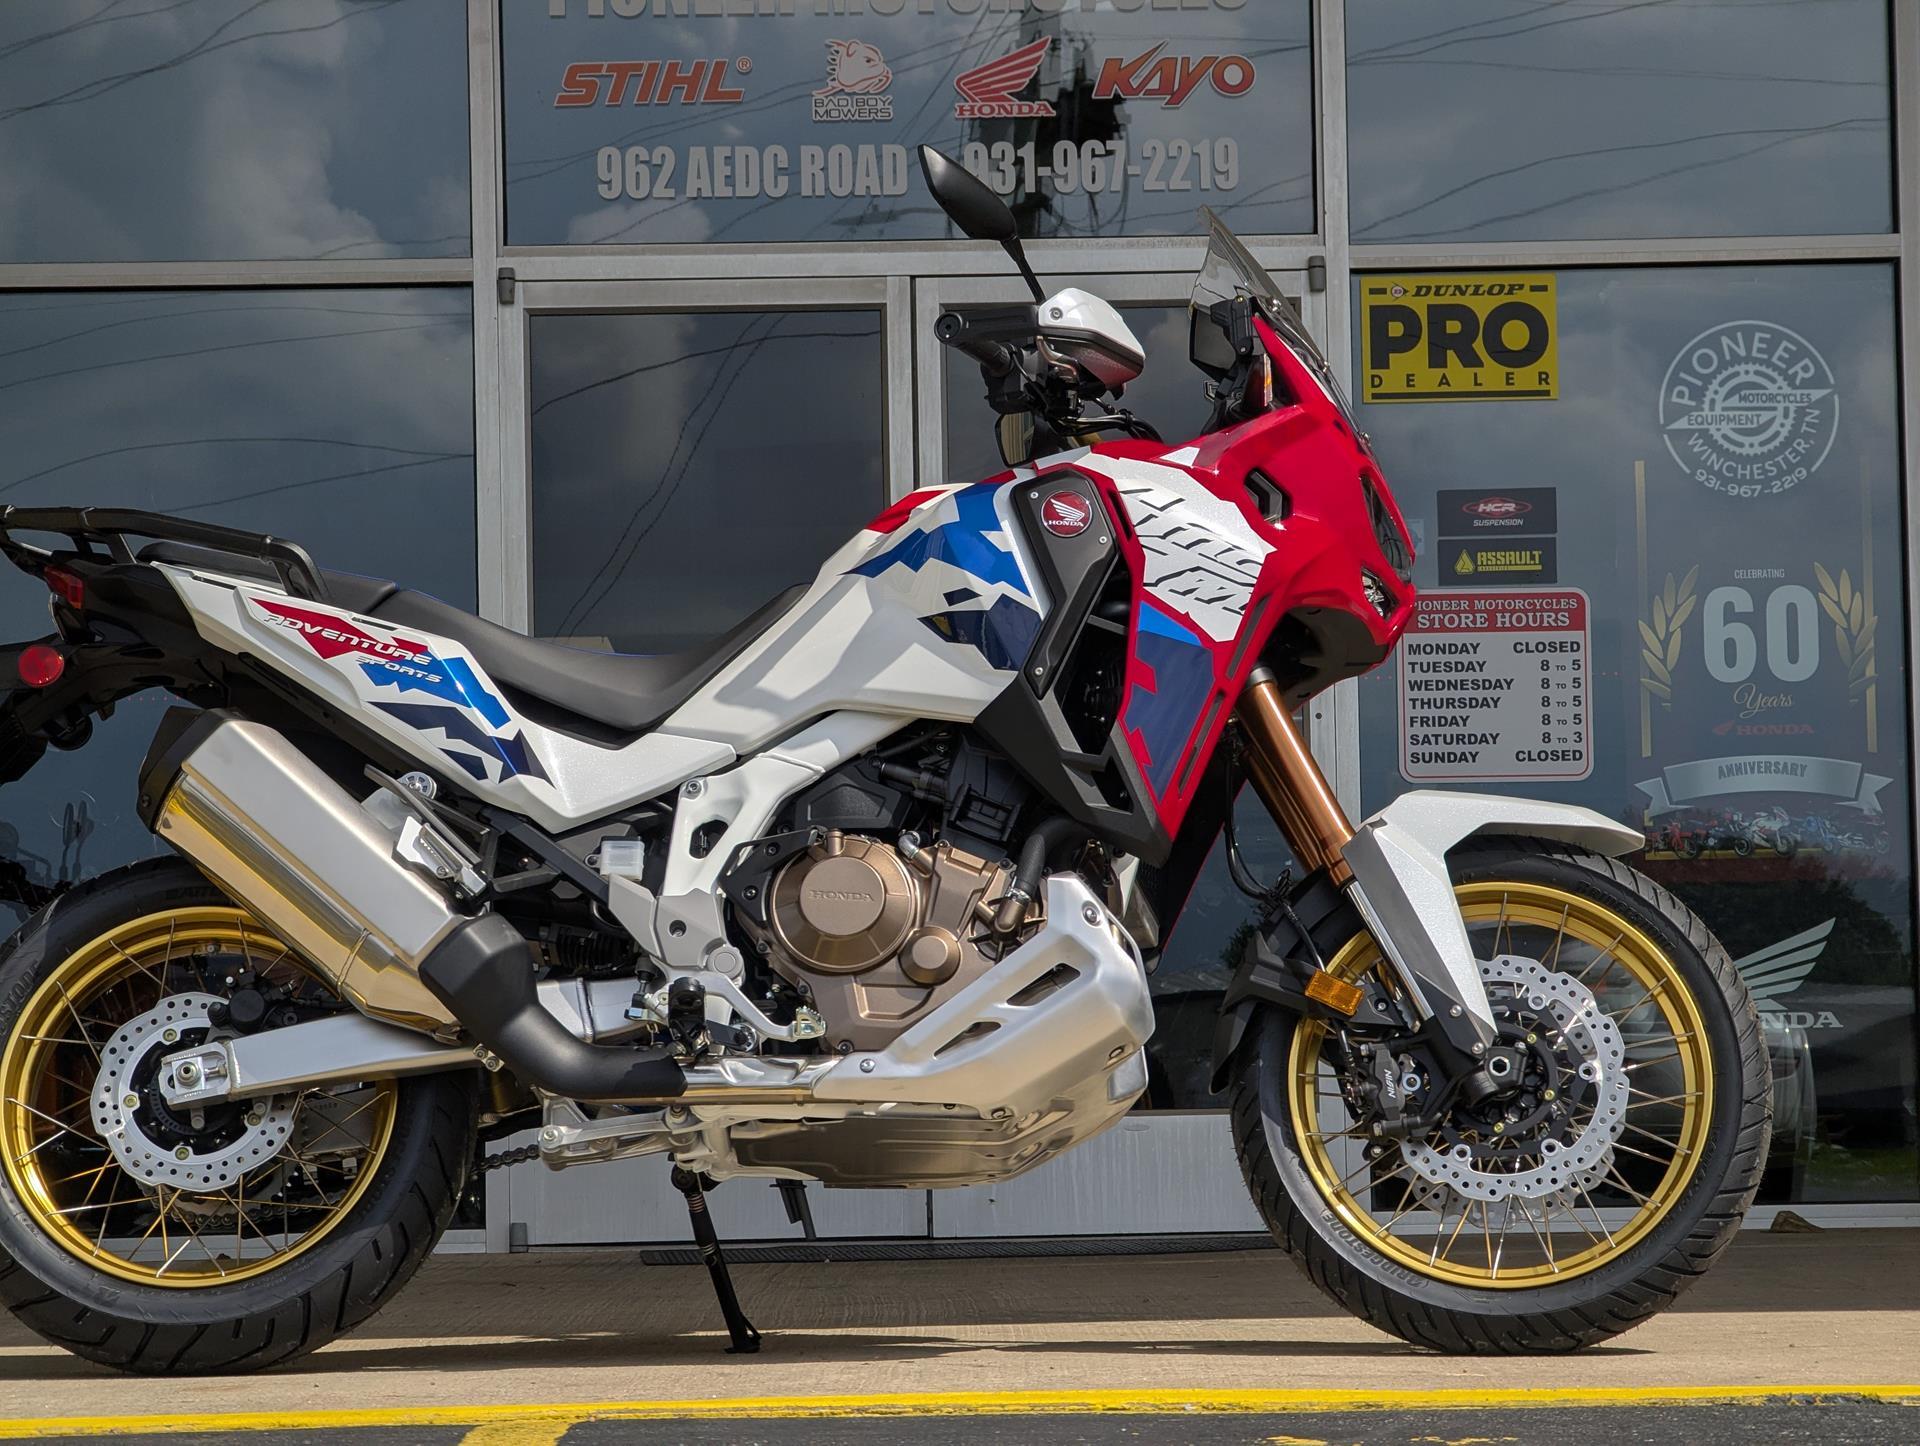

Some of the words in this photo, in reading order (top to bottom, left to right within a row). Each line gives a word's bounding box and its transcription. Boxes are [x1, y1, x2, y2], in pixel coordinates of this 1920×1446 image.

[1094, 40, 1255, 108] KAYO
[554, 60, 745, 106] STIHL
[814, 98, 849, 107] BAD
[855, 97, 891, 107] BOY
[814, 108, 891, 119] MOWERS
[955, 103, 1056, 118] HONDA
[597, 145, 676, 199] 962
[686, 145, 789, 198] AEDC
[800, 143, 909, 197] ROAD
[1412, 283, 1525, 297] DUNLOP
[1369, 301, 1549, 370] PRO
[1672, 332, 1815, 406] PIONEER
[1370, 371, 1550, 389] DEALER
[1738, 392, 1813, 405] MOTORCYCLES
[1687, 413, 1762, 427] EQUIPMENT
[1801, 408, 1821, 433] TN
[1695, 467, 1808, 497] 931-967-2219
[1477, 503, 1516, 512] HCR
[1473, 518, 1524, 527] SUSPENSION
[1477, 550, 1542, 565] ASSAULT
[1734, 568, 1785, 579] CELEBRATING
[1474, 598, 1578, 610] MOTORCYCLES
[1417, 613, 1489, 629] STORE
[1496, 611, 1570, 627] HOURS
[264, 614, 433, 666] ADVENTURE
[1703, 585, 1820, 683] 60
[1408, 642, 1481, 655] MONDAY
[1513, 641, 1581, 654] CLOSED
[355, 655, 443, 683] SPORTS
[1408, 660, 1487, 673] TUESDAY
[1540, 659, 1550, 672] 8
[1555, 664, 1567, 672] TO
[1572, 659, 1581, 671] 5
[1408, 678, 1515, 692] WEDNESDAY
[1540, 677, 1550, 690] 8
[1555, 682, 1567, 690] TO
[1572, 677, 1582, 689] 5
[1409, 697, 1501, 710] THURSDAY
[1541, 695, 1551, 708] 8
[1572, 695, 1582, 707] 5
[1733, 683, 1793, 719] Years
[1409, 715, 1471, 728] FRIDAY
[1541, 713, 1551, 726] 8
[1572, 713, 1582, 725] 5
[1737, 723, 1815, 736] HONDA
[1409, 732, 1500, 746] SATURDAY
[1541, 731, 1551, 744] 8
[1573, 731, 1583, 744] 3
[1410, 751, 1480, 764] SUNDAY
[1515, 750, 1583, 762] CLOSED
[1718, 761, 1808, 781] ANNIVERSARY
[808, 889, 875, 901] HONDA
[1759, 1011, 1844, 1029] NDA
